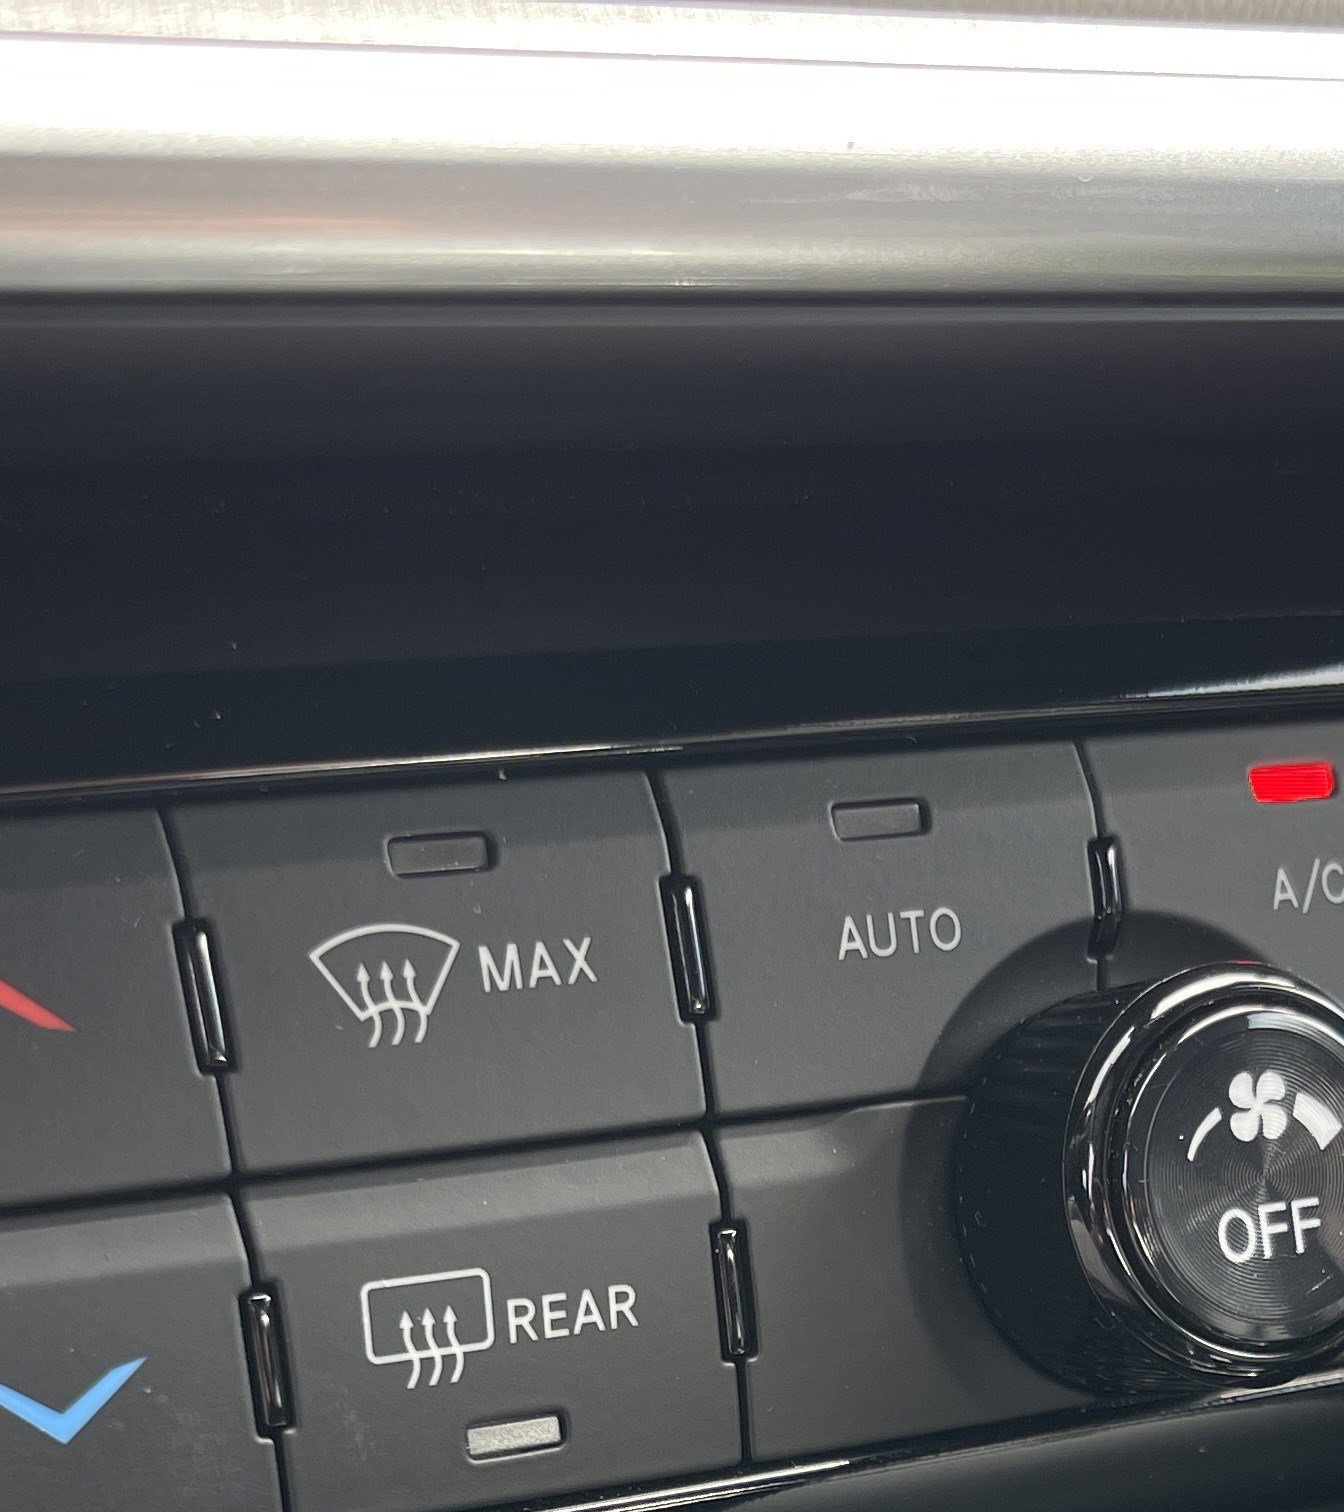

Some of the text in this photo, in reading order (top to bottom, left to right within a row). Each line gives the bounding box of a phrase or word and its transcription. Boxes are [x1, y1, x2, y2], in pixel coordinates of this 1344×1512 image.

[837, 906, 962, 962] AUTO
[477, 937, 598, 994] MAX
[1216, 1196, 1323, 1268] OFF
[505, 1284, 640, 1344] REAR
